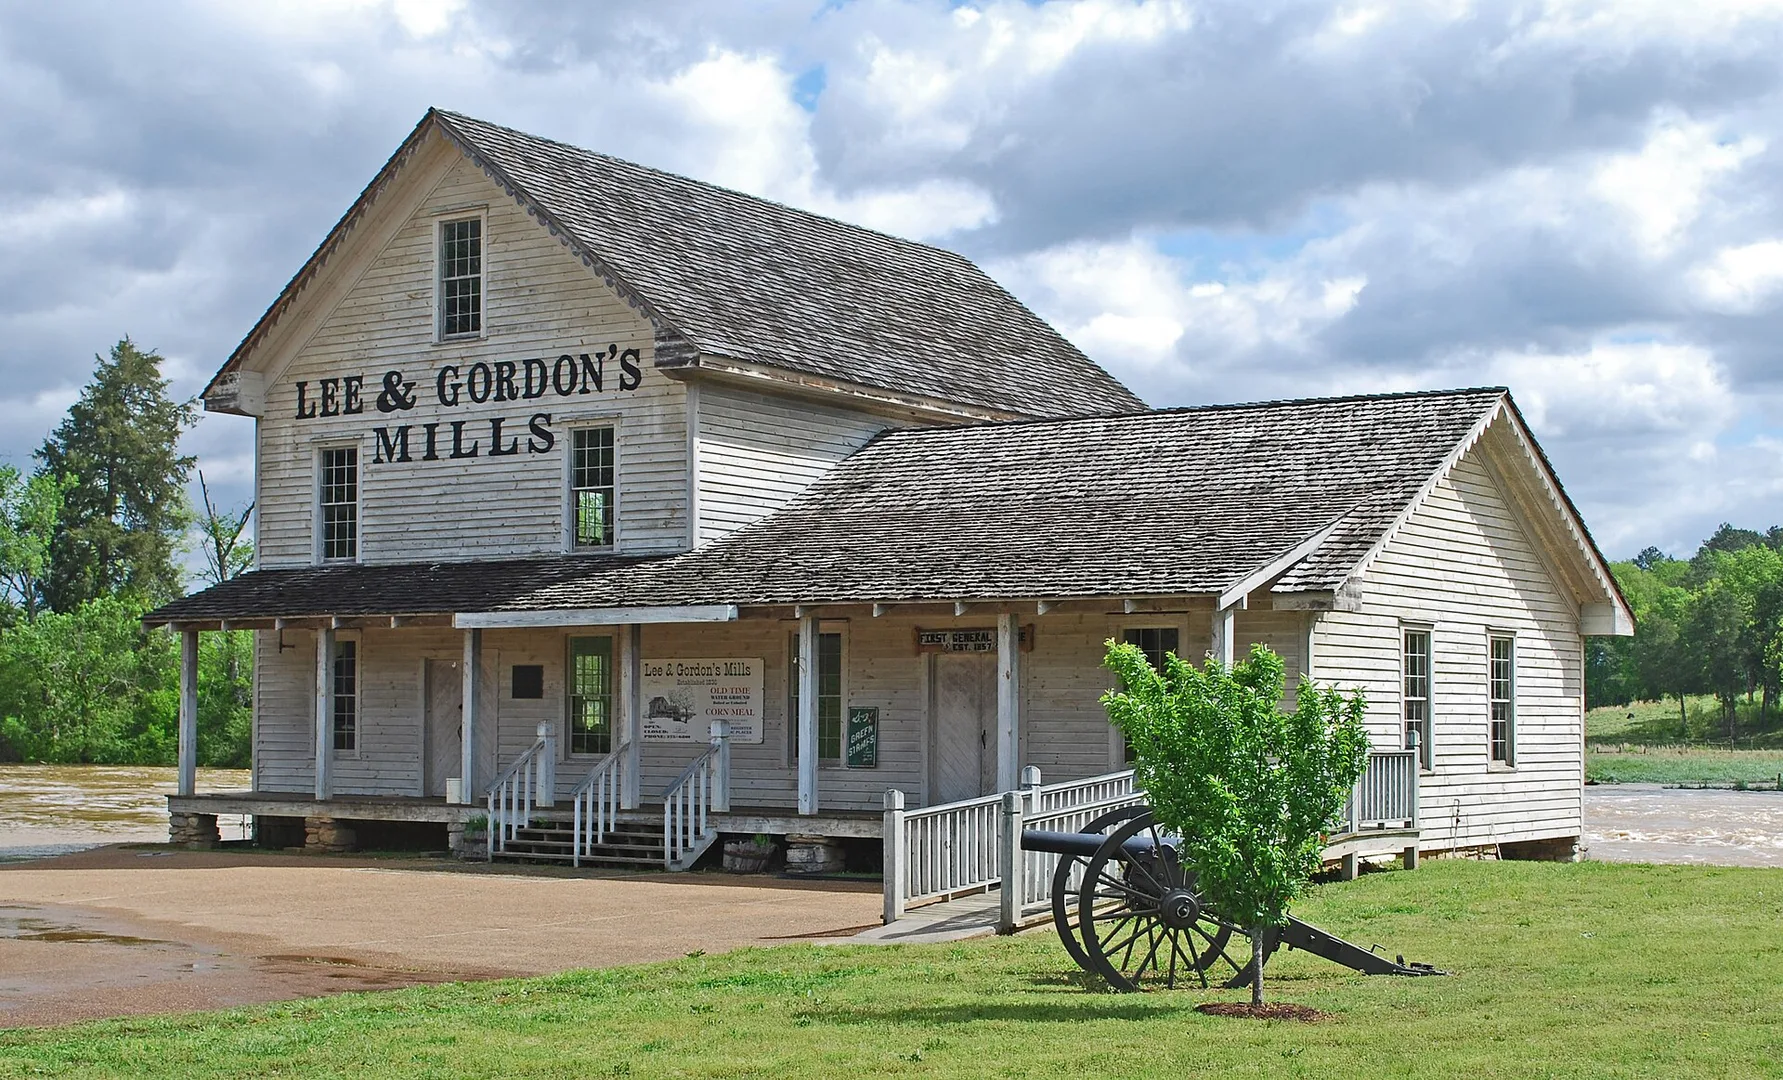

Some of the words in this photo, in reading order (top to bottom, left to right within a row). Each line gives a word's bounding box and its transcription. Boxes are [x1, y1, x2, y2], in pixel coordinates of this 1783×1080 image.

[295, 375, 364, 420] LEE
[376, 370, 417, 414] &
[437, 344, 642, 407] GORDON'S
[373, 413, 555, 464] MILLS
[920, 633, 947, 643] FIRST
[952, 632, 992, 642] GENERAL
[953, 643, 971, 651] EST.
[644, 663, 663, 677] Lee
[666, 663, 673, 676] &
[676, 662, 721, 677] Gordon's
[724, 662, 751, 676] Mills
[705, 708, 729, 716] CORN
[851, 725, 873, 744] GREEN
[849, 735, 875, 757] STAMPS
